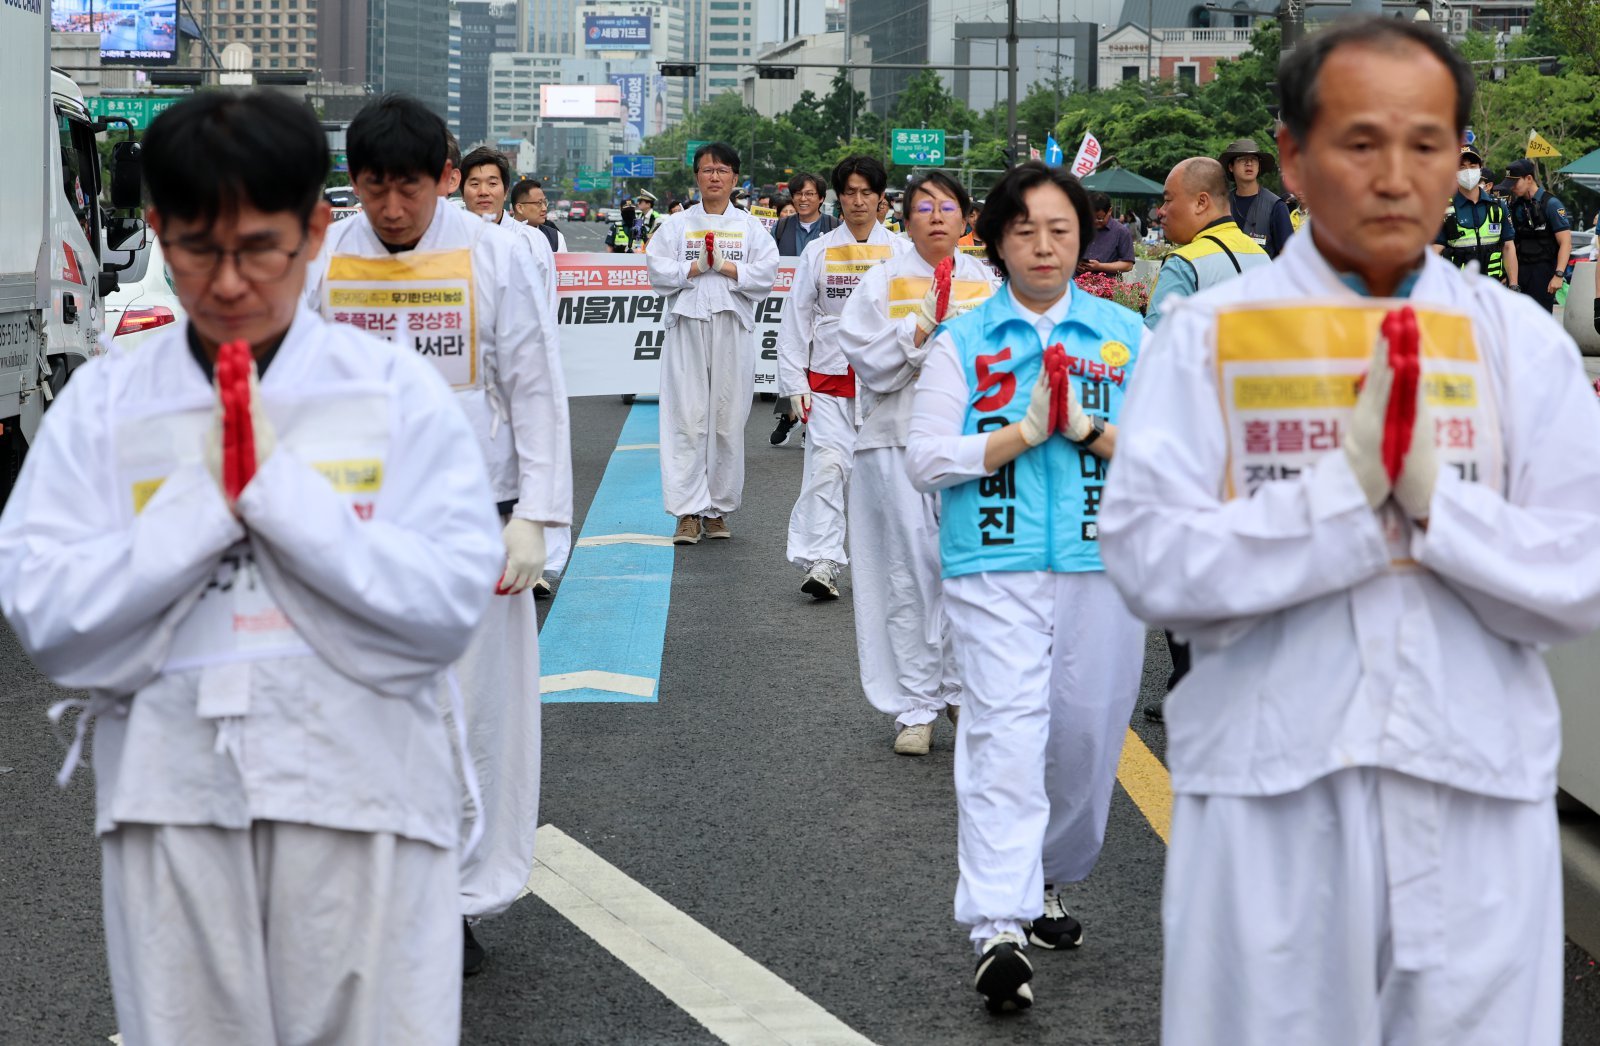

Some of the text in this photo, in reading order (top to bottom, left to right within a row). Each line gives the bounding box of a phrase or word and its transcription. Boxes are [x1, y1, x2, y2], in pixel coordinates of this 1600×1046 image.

[601, 27, 646, 38] 세종기프트
[897, 132, 940, 144] 종로1가
[685, 251, 701, 260] 정부
[607, 269, 651, 286] 정상화
[827, 275, 860, 285] 홈플러스
[391, 292, 421, 304] 무기한
[422, 292, 442, 303] 단식
[443, 291, 462, 302] 농성
[557, 295, 667, 325] 서울지역
[407, 312, 463, 331] 정상화
[973, 347, 1017, 413] 5
[1244, 417, 1341, 455] 홈플러
[1079, 382, 1110, 516] 비대표
